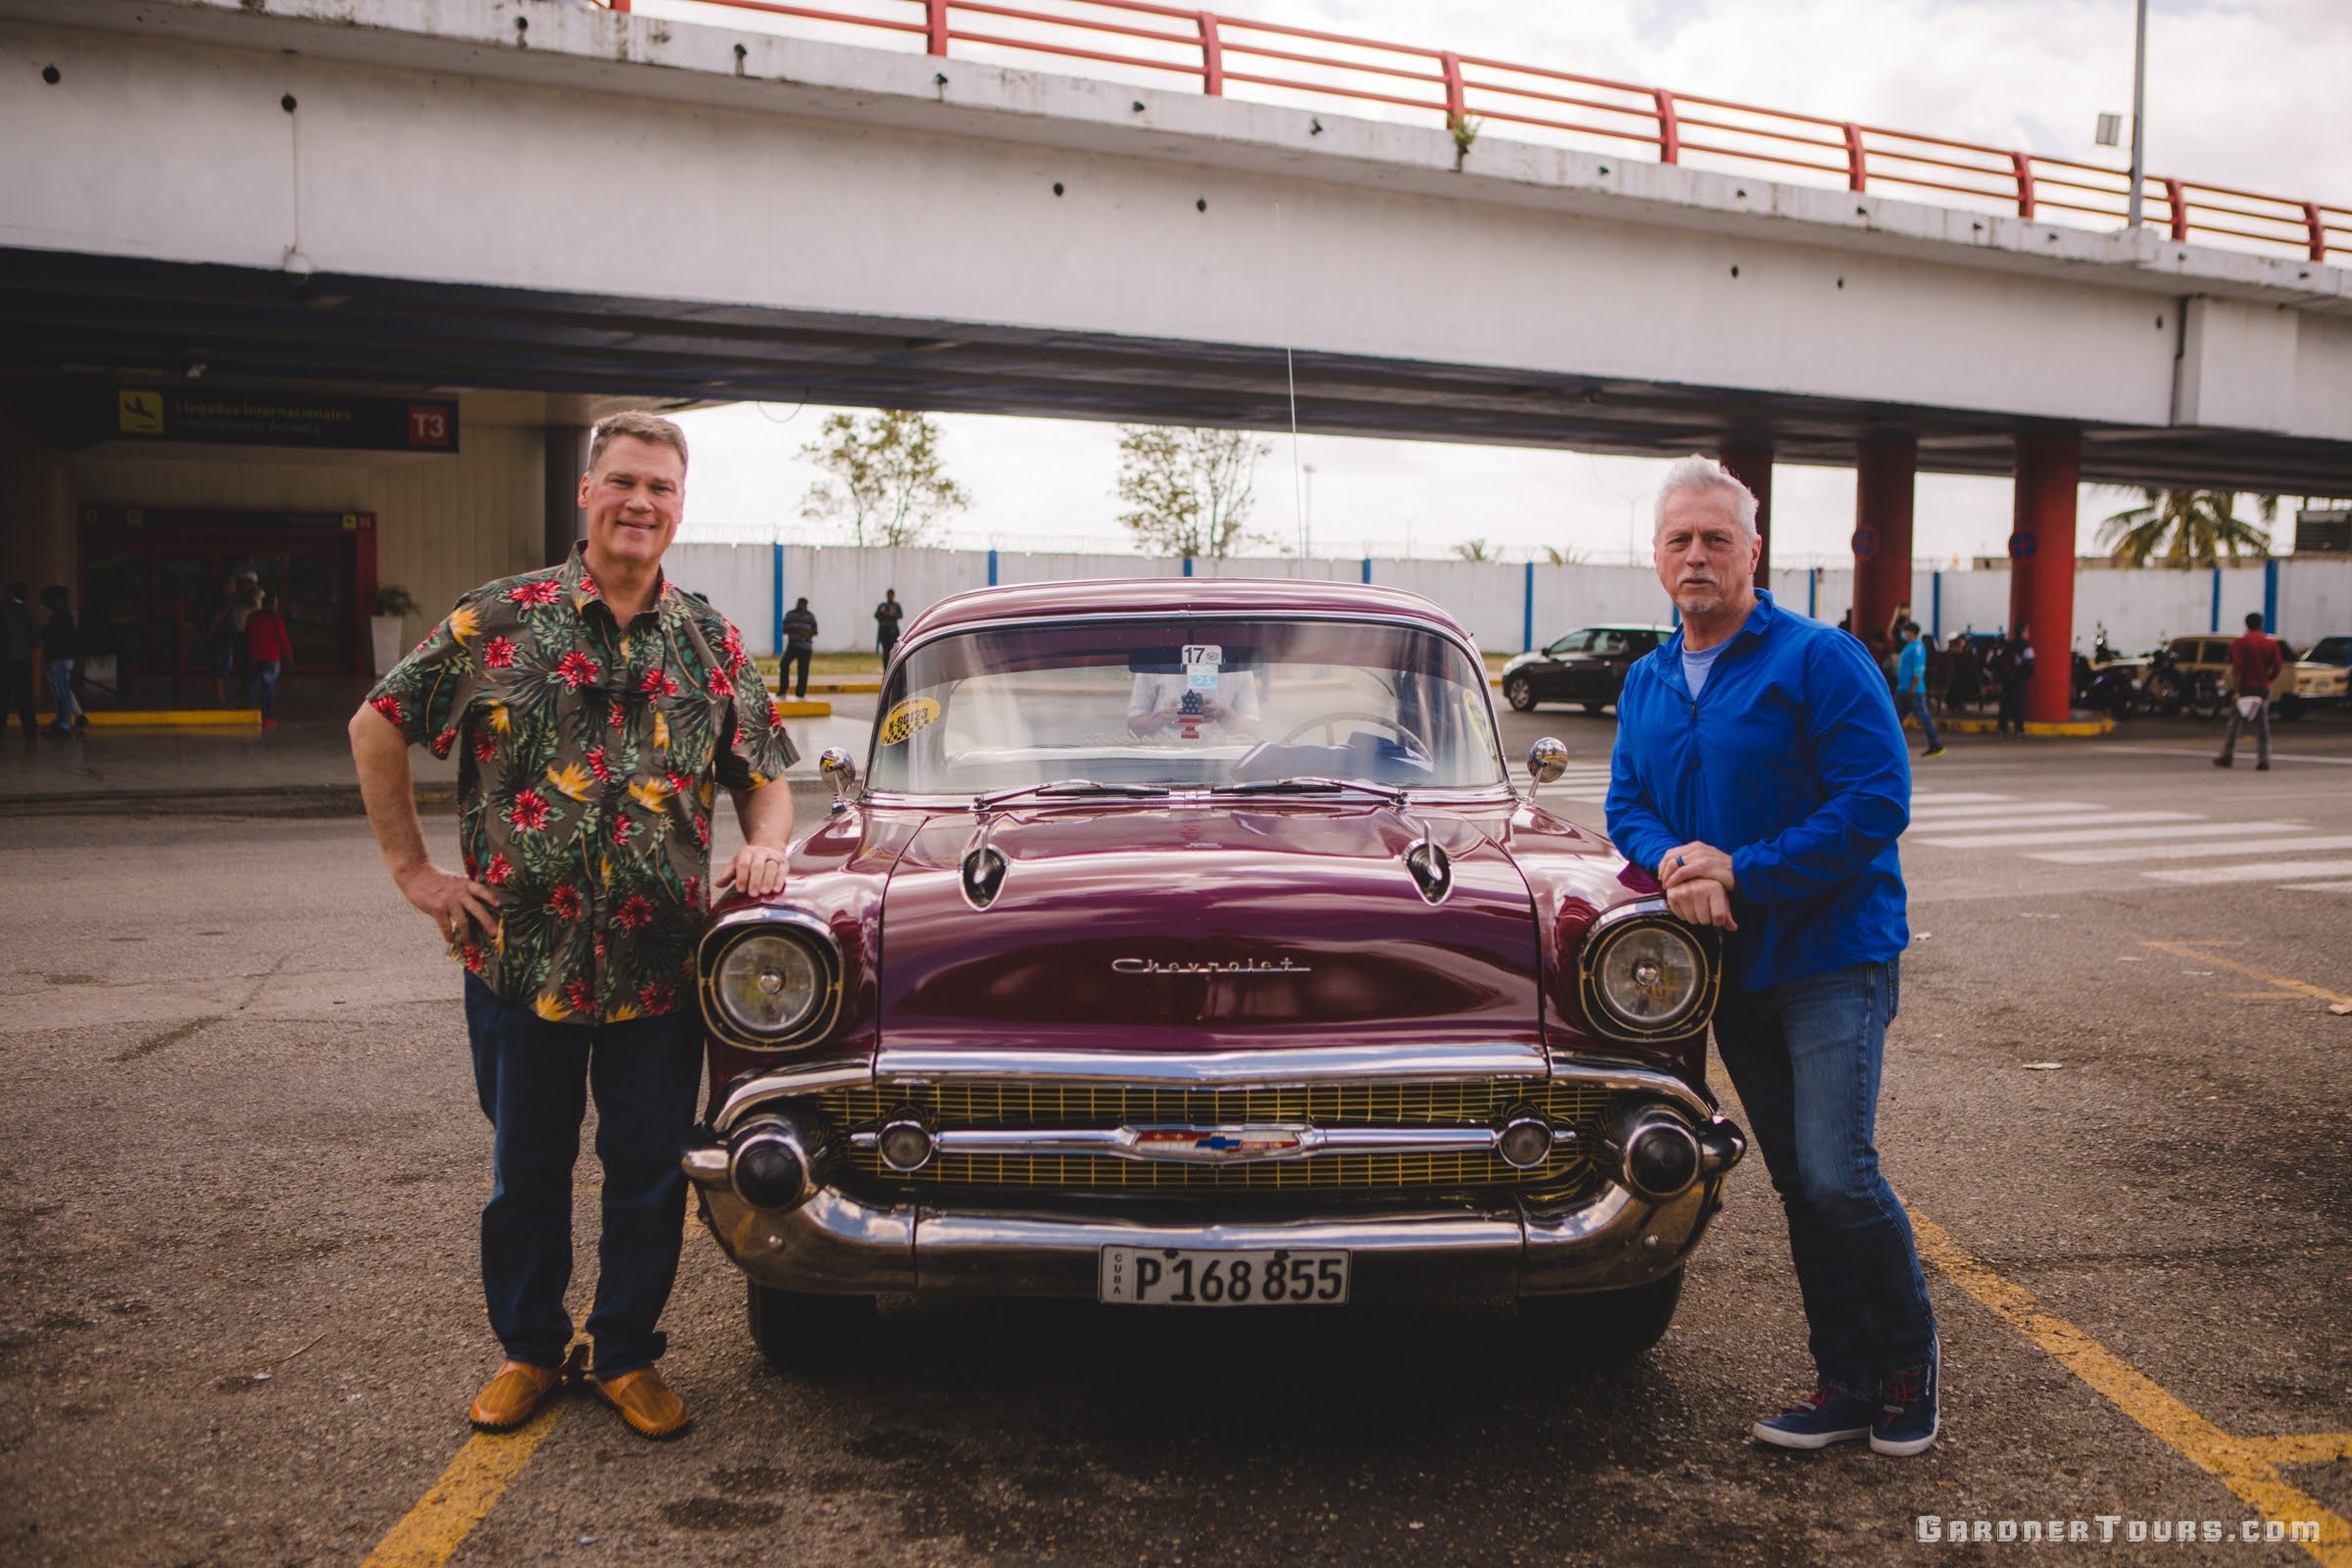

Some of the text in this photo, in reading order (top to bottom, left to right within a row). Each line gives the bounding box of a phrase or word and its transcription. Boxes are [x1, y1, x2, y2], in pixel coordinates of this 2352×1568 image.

[413, 413, 445, 439] T3
[1184, 647, 1205, 663] 17
[1111, 956, 1298, 973] Chevrolet
[1112, 1253, 1122, 1296] CUBA
[1261, 1258, 1343, 1301] 855
